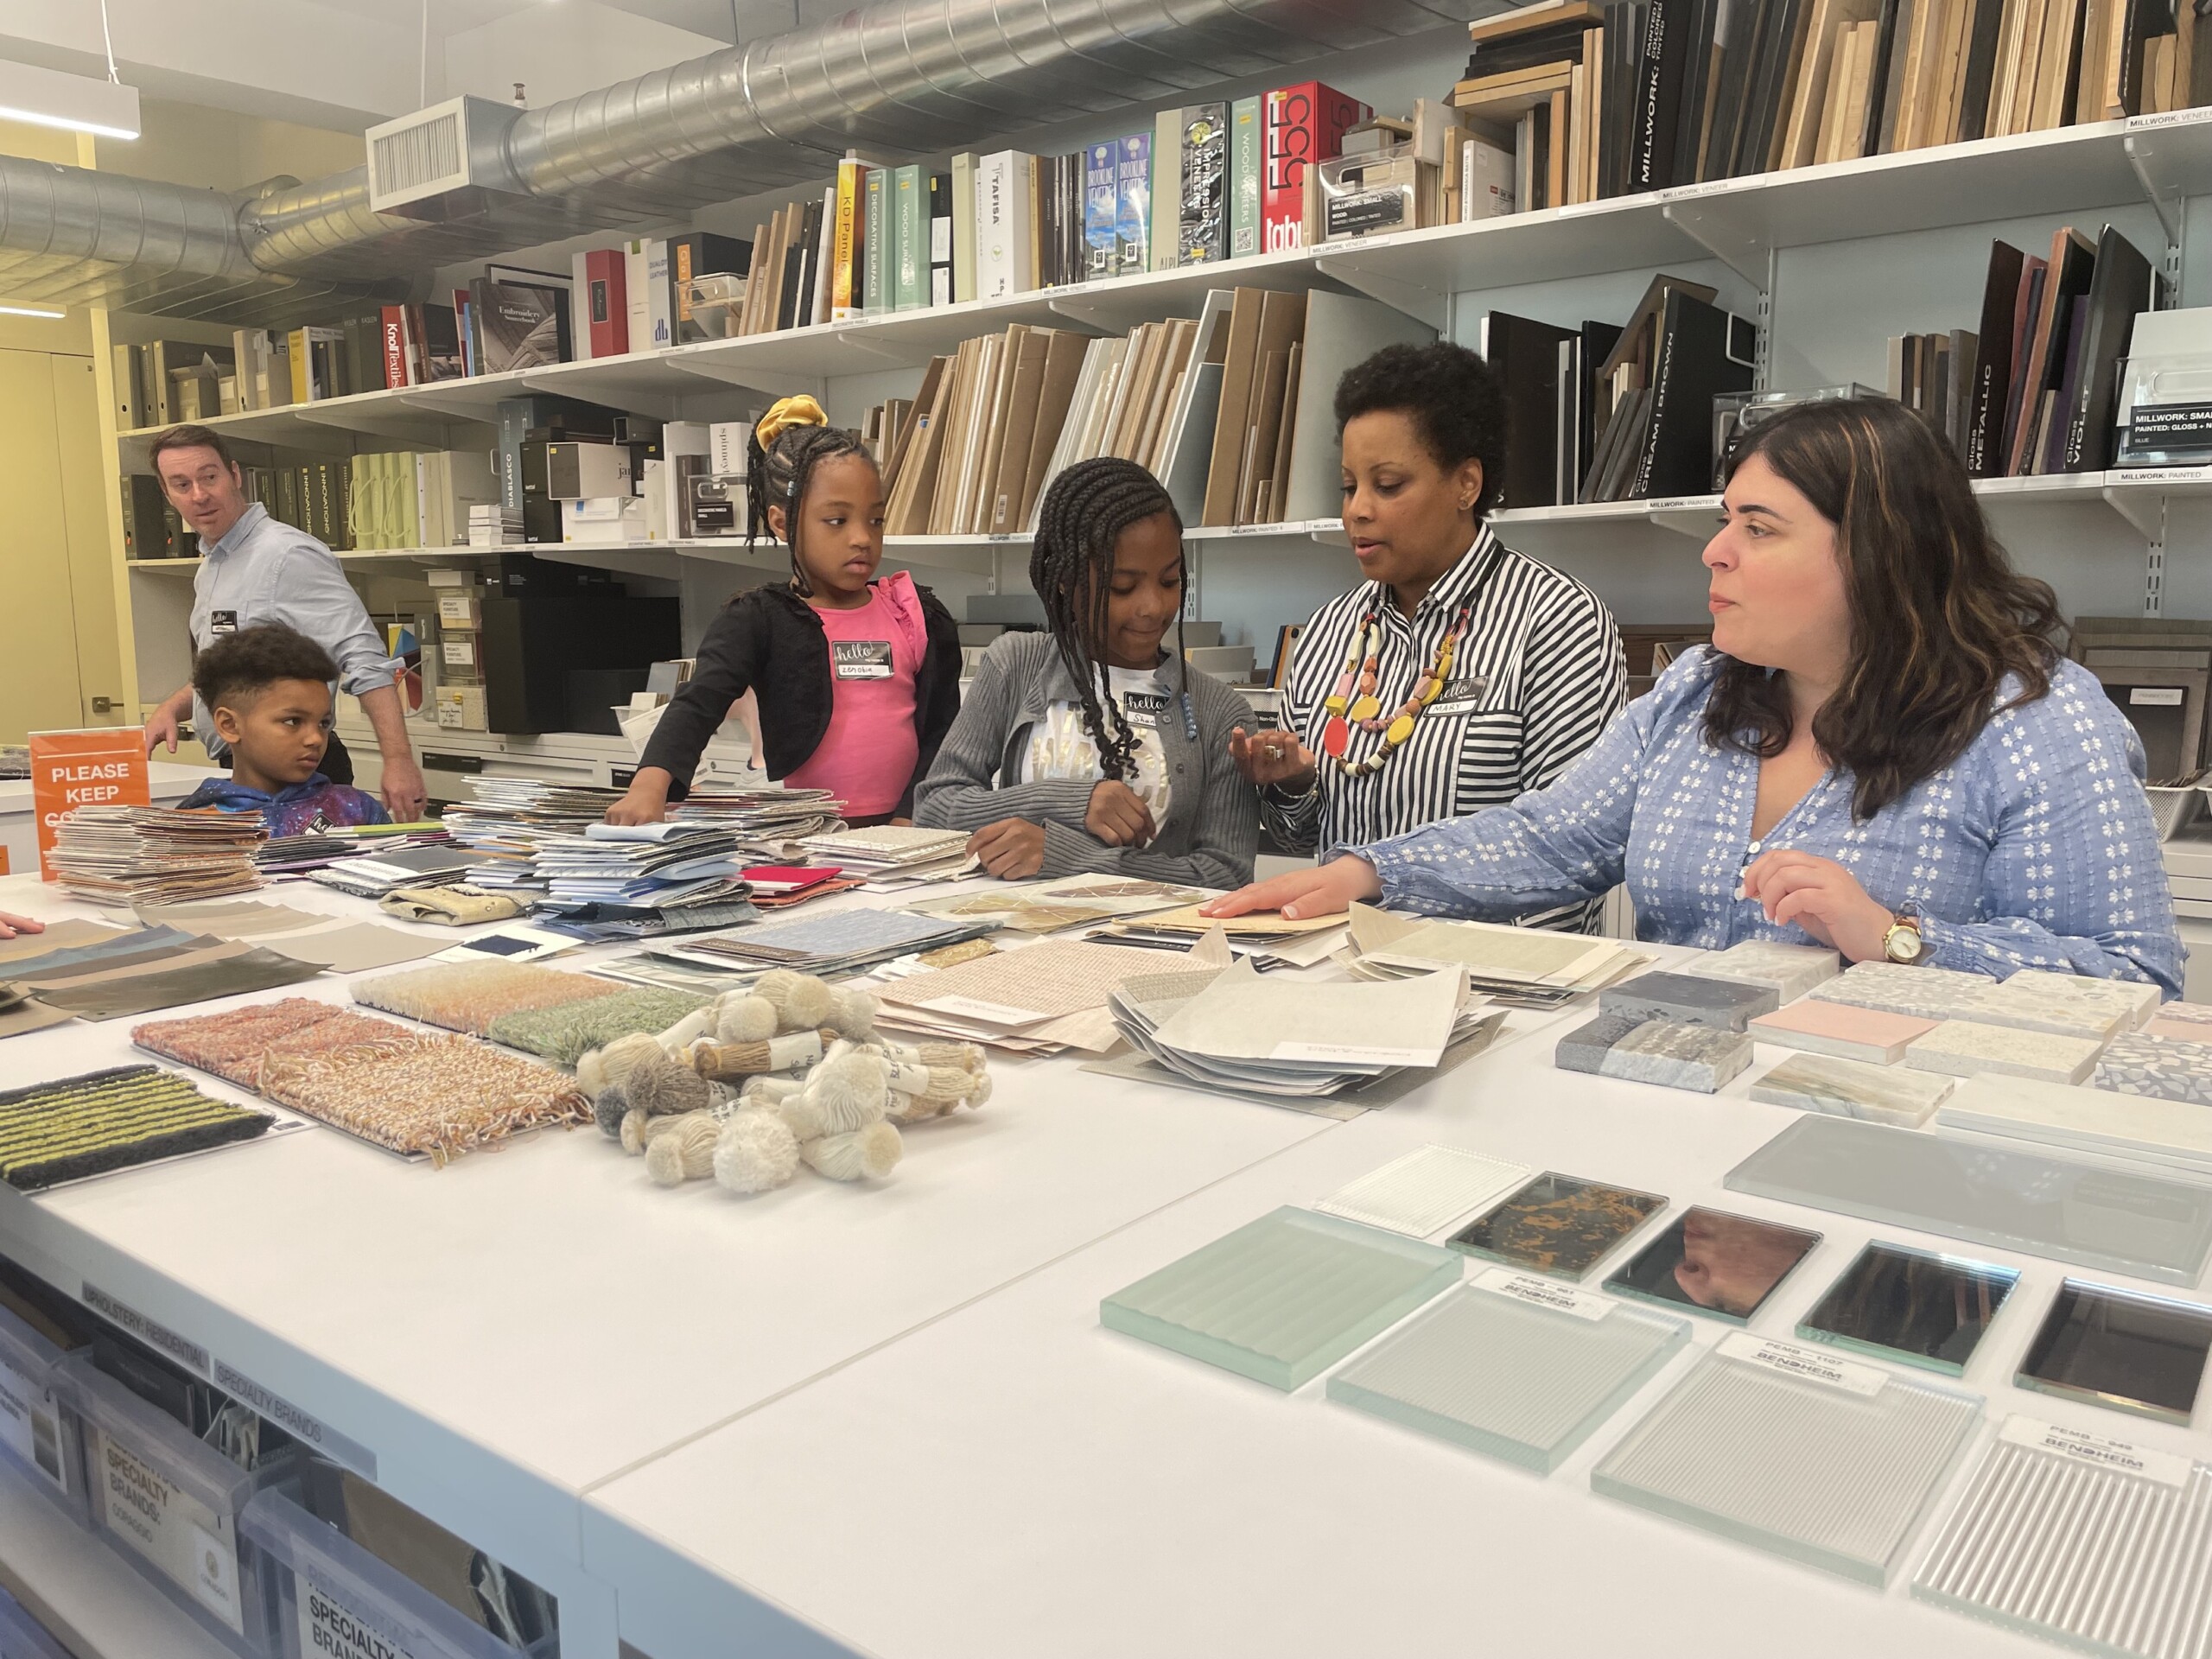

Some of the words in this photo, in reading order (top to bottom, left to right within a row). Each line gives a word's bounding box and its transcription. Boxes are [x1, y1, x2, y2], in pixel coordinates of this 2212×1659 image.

[1656, 20, 1665, 60] TINTED
[1642, 66, 1659, 182] MILLWORK:
[2130, 116, 2179, 127] MILLWORK:
[1088, 166, 1114, 184] BROOKLINE
[1119, 159, 1149, 179] BROOKLINE
[992, 177, 1004, 226] TAFISA
[1202, 148, 1211, 229] IMPRESSION
[1662, 188, 1700, 199] MILLWORK:
[1701, 183, 1728, 193] VENEER
[842, 197, 851, 216] KD
[1332, 200, 1363, 210] MILLWORK:
[840, 222, 851, 271] Panels
[1313, 244, 1344, 254] MILLWORK:
[1345, 239, 1367, 248] VENEER
[1044, 288, 1068, 296] MILLWORK:
[499, 306, 540, 318] Embroidery
[1642, 423, 1660, 493] CREAM
[1658, 332, 1673, 408] BROWN
[1975, 364, 1992, 470] METALLIC
[2074, 385, 2089, 464] VIOLET
[2136, 413, 2187, 423] MILLWORK:
[1968, 429, 1977, 470] Gloss
[2067, 420, 2078, 463] Gloss
[1636, 456, 1647, 493] Gloss
[321, 473, 331, 534] INNOVATIONS
[837, 641, 873, 661] hello
[1128, 696, 1166, 709] hello
[1434, 703, 1462, 712] MARY
[52, 763, 129, 782] PLEASE
[66, 785, 119, 803] KEEP
[145, 1322, 205, 1368] RESIDENTIAL
[1765, 1341, 1801, 1355] PEMB
[1816, 1355, 1843, 1366] 1107
[1756, 1352, 1843, 1380] BENDHEIM
[218, 1365, 273, 1413] SPECIALTY
[274, 1400, 322, 1443] BRANDS
[2050, 1425, 2091, 1440] PEMB
[2045, 1437, 2144, 1468] BENDHEIM
[107, 1448, 168, 1507] SPECIALTY
[110, 1473, 161, 1526] BRANDS:
[112, 1503, 153, 1543] CORAGGIO
[309, 1595, 395, 1659] SPECIALTY
